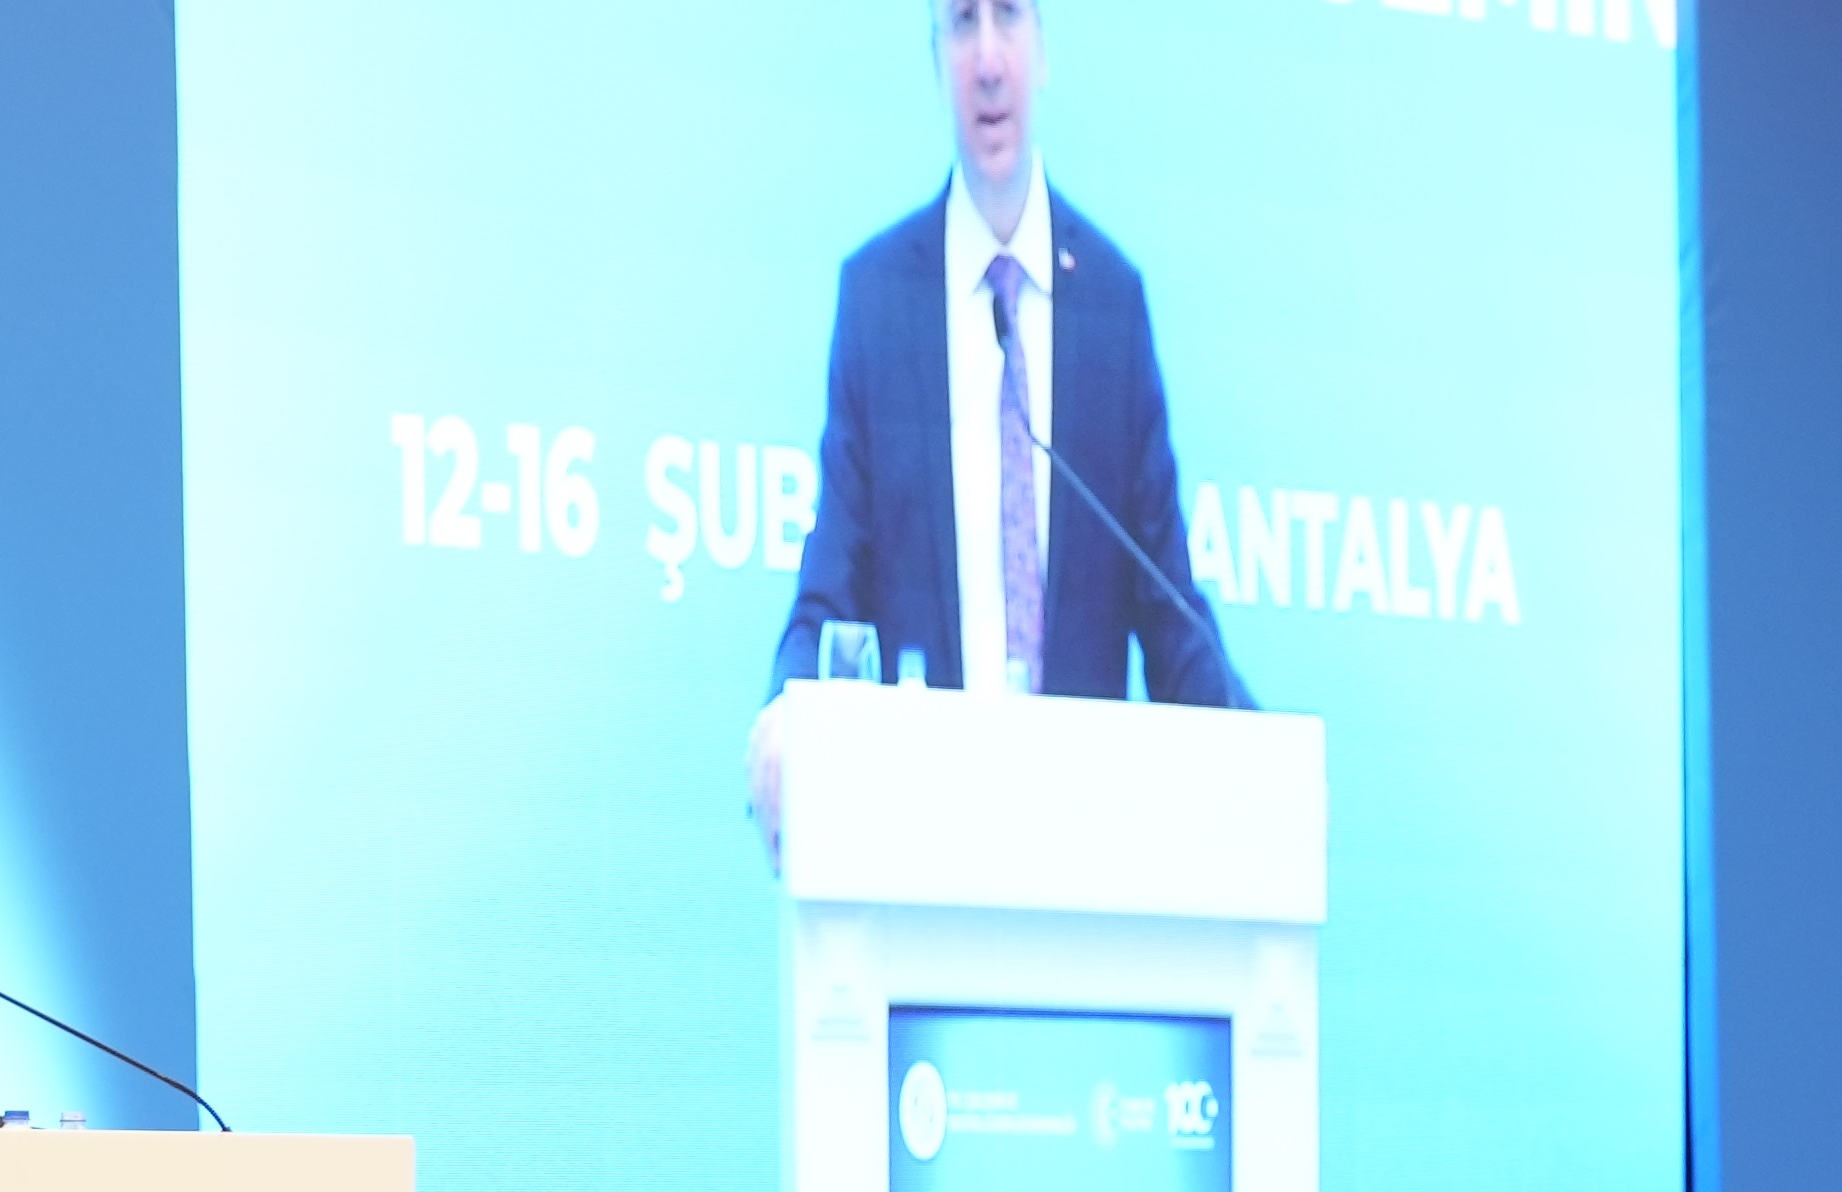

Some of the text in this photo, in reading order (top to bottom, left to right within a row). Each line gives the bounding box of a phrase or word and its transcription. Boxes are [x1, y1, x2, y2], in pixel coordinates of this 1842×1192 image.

[390, 412, 1521, 626] 12-16 ŞUB ANTALYA
